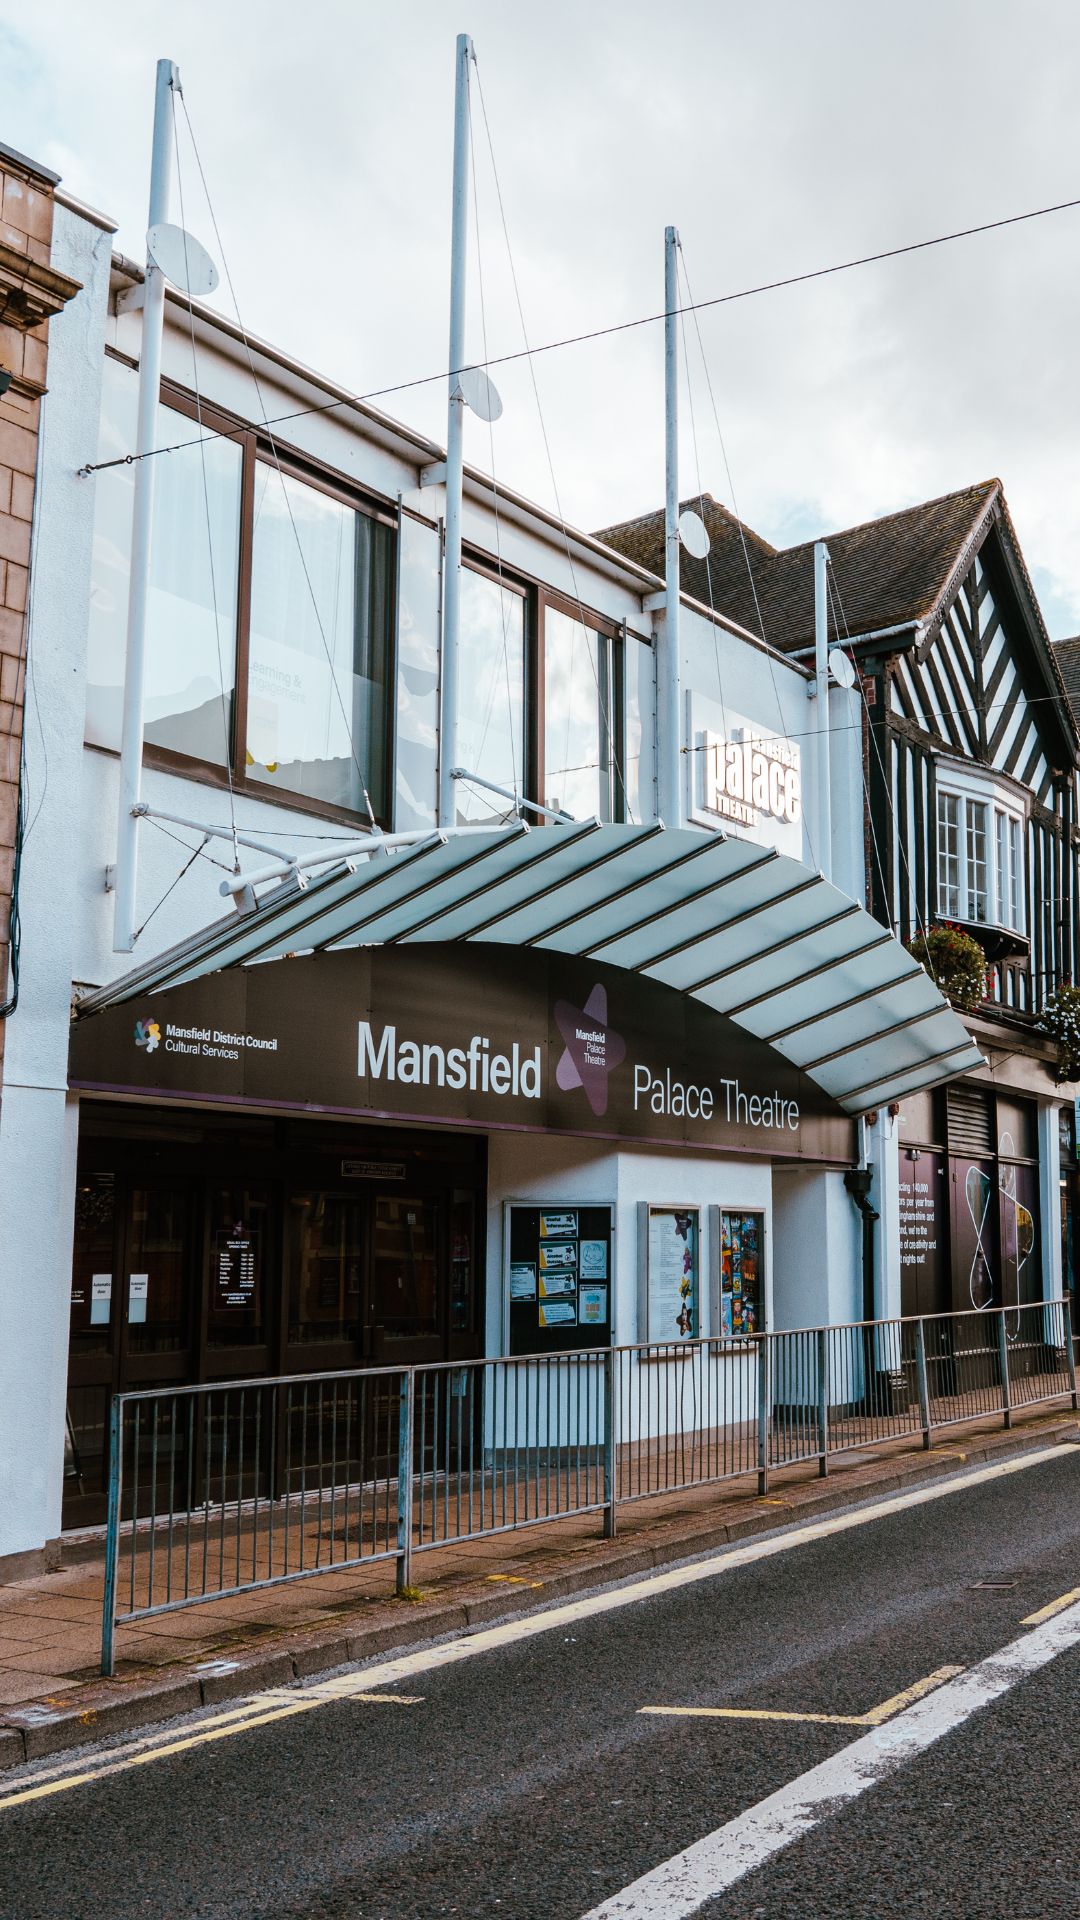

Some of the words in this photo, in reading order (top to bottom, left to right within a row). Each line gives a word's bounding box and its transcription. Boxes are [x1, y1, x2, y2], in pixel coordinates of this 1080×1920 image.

[704, 727, 801, 824] palace
[166, 1023, 211, 1041] Mansfield
[213, 1030, 245, 1046] District
[246, 1035, 278, 1051] Council
[575, 1028, 606, 1044] Mansfield
[165, 1039, 201, 1055] Cultural
[202, 1043, 239, 1060] Services
[586, 1041, 606, 1055] Palace
[583, 1052, 606, 1066] Theatre
[357, 1020, 541, 1099] Mansfield
[633, 1063, 714, 1121] Palace
[720, 1078, 800, 1131] Theatre
[925, 1197, 935, 1208] from
[926, 1211, 935, 1222] and
[920, 1225, 928, 1235] the
[904, 1239, 909, 1249] of
[928, 1239, 937, 1250] and
